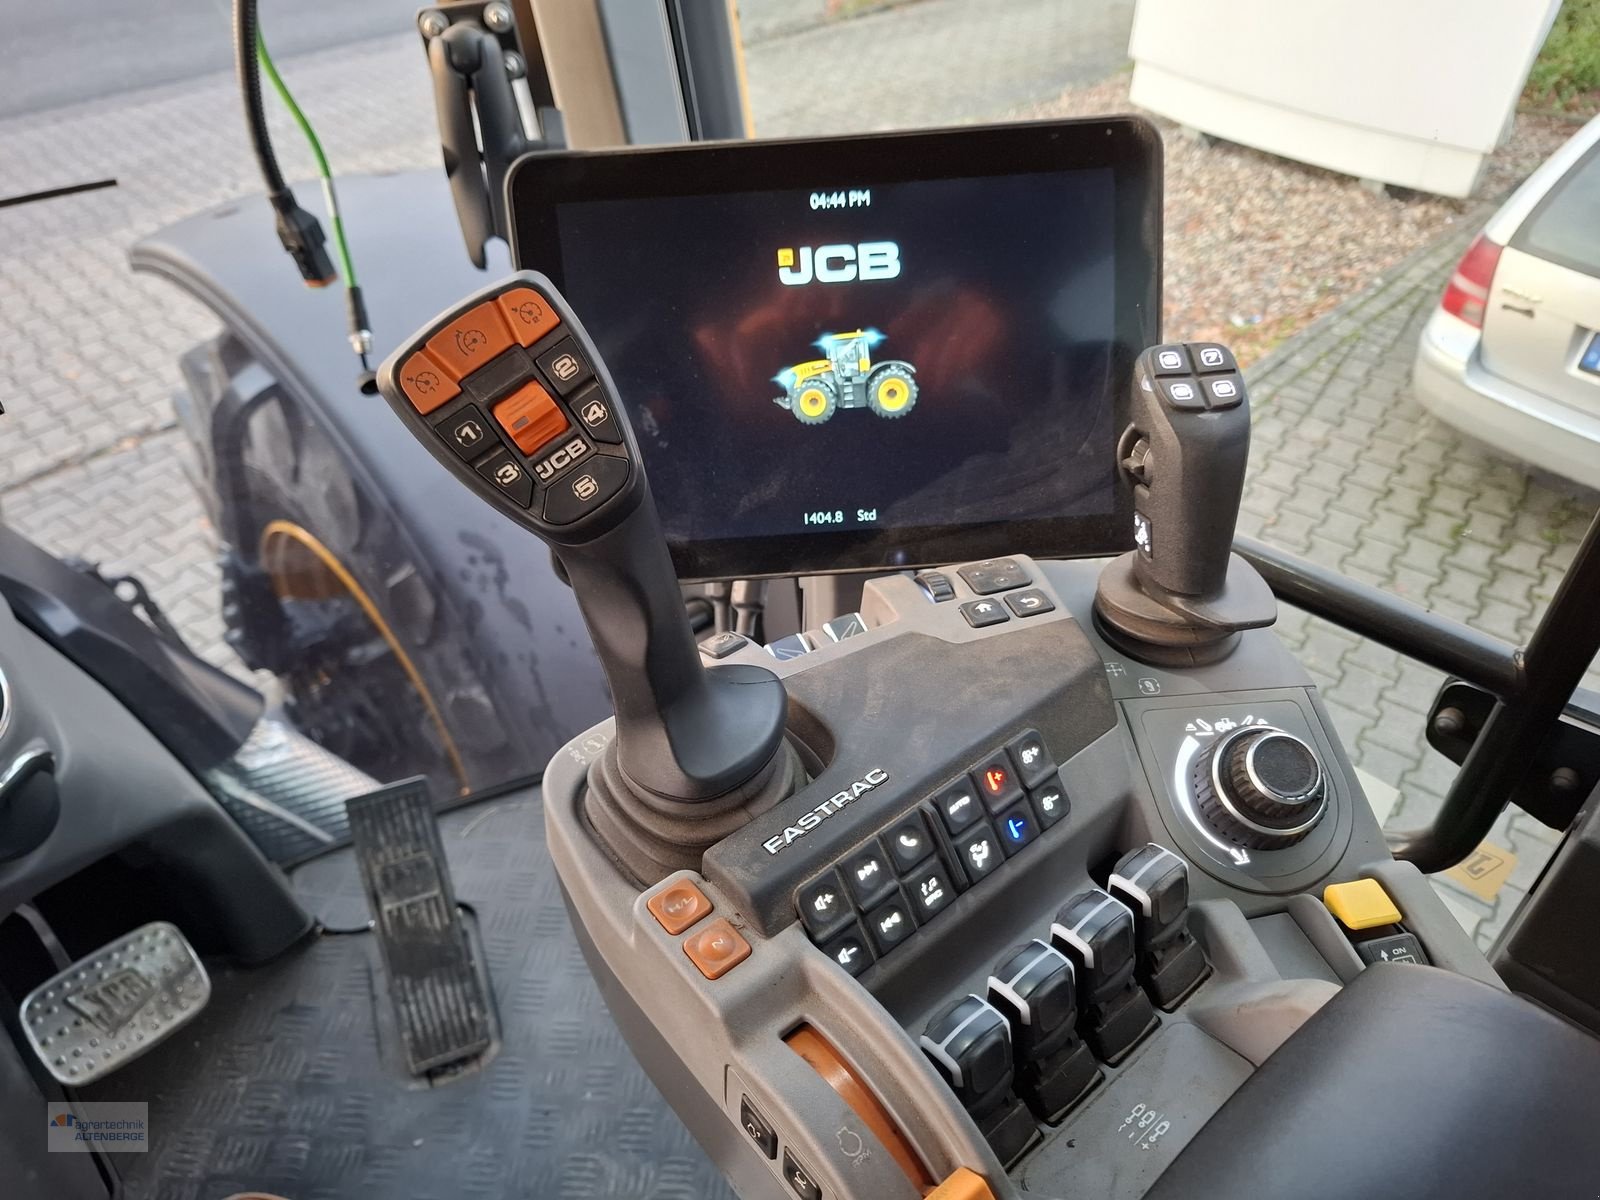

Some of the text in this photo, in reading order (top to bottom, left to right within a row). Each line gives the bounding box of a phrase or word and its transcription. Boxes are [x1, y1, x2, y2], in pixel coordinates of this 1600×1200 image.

[810, 189, 871, 210] 04:44 PM
[777, 241, 901, 286] JCB
[555, 357, 576, 378] 2
[587, 403, 606, 422] 4
[535, 439, 587, 480] JCB
[499, 464, 519, 484] 3
[574, 477, 595, 499] 5
[804, 508, 877, 525] 1404.8 Std
[762, 768, 889, 855] FASTRAC
[1392, 946, 1407, 955] ON
